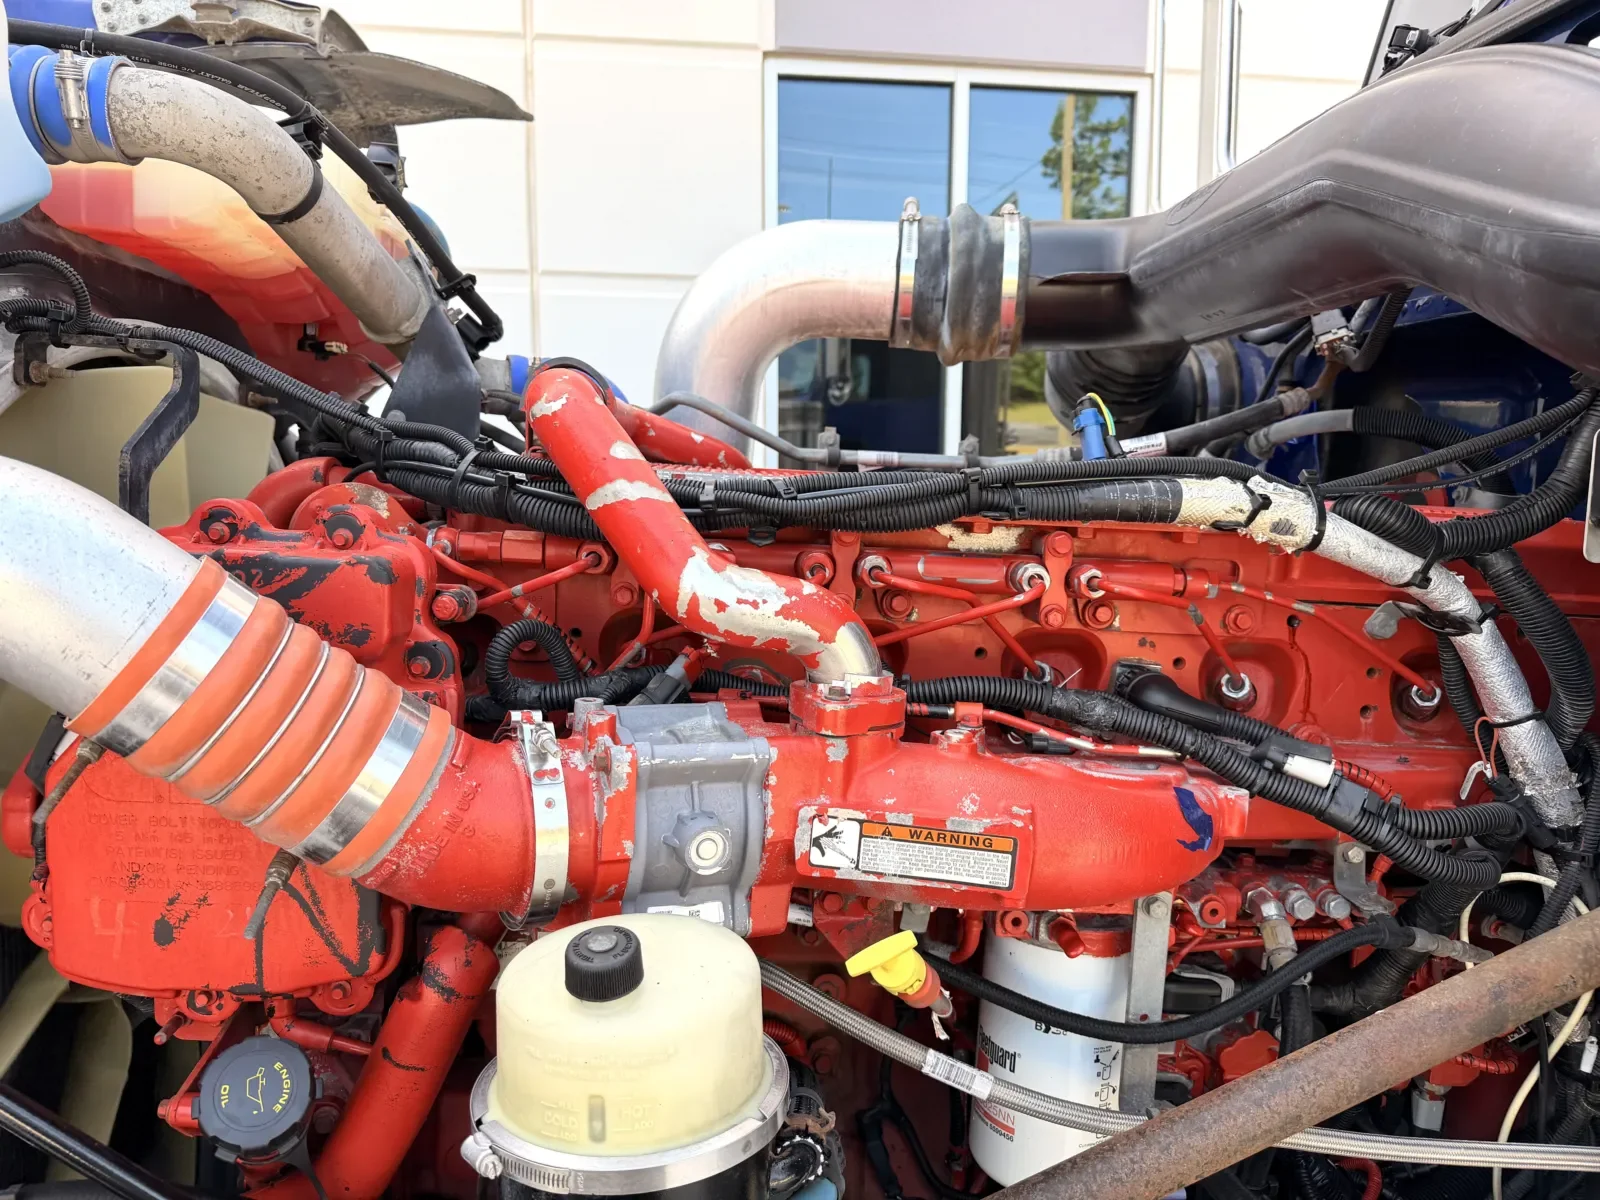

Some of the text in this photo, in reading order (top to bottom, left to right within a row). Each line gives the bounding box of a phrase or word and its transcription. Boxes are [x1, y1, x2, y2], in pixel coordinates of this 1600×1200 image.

[157, 60, 179, 69] HOSE
[198, 70, 232, 85] GALAXY
[236, 84, 288, 111] GOODYEAR
[87, 813, 247, 830] COVER BOLT TORQU
[444, 813, 465, 834] IN
[908, 828, 994, 849] WARNING
[192, 849, 244, 861] ISSUED
[111, 861, 241, 877] AND/OR PENDING
[572, 942, 595, 963] TIGHTEN
[220, 1084, 230, 1109] OIL
[272, 1061, 291, 1114] ENGINE
[543, 1111, 579, 1130] COLD
[619, 1103, 653, 1120] HOT
[633, 1120, 655, 1131] ADD
